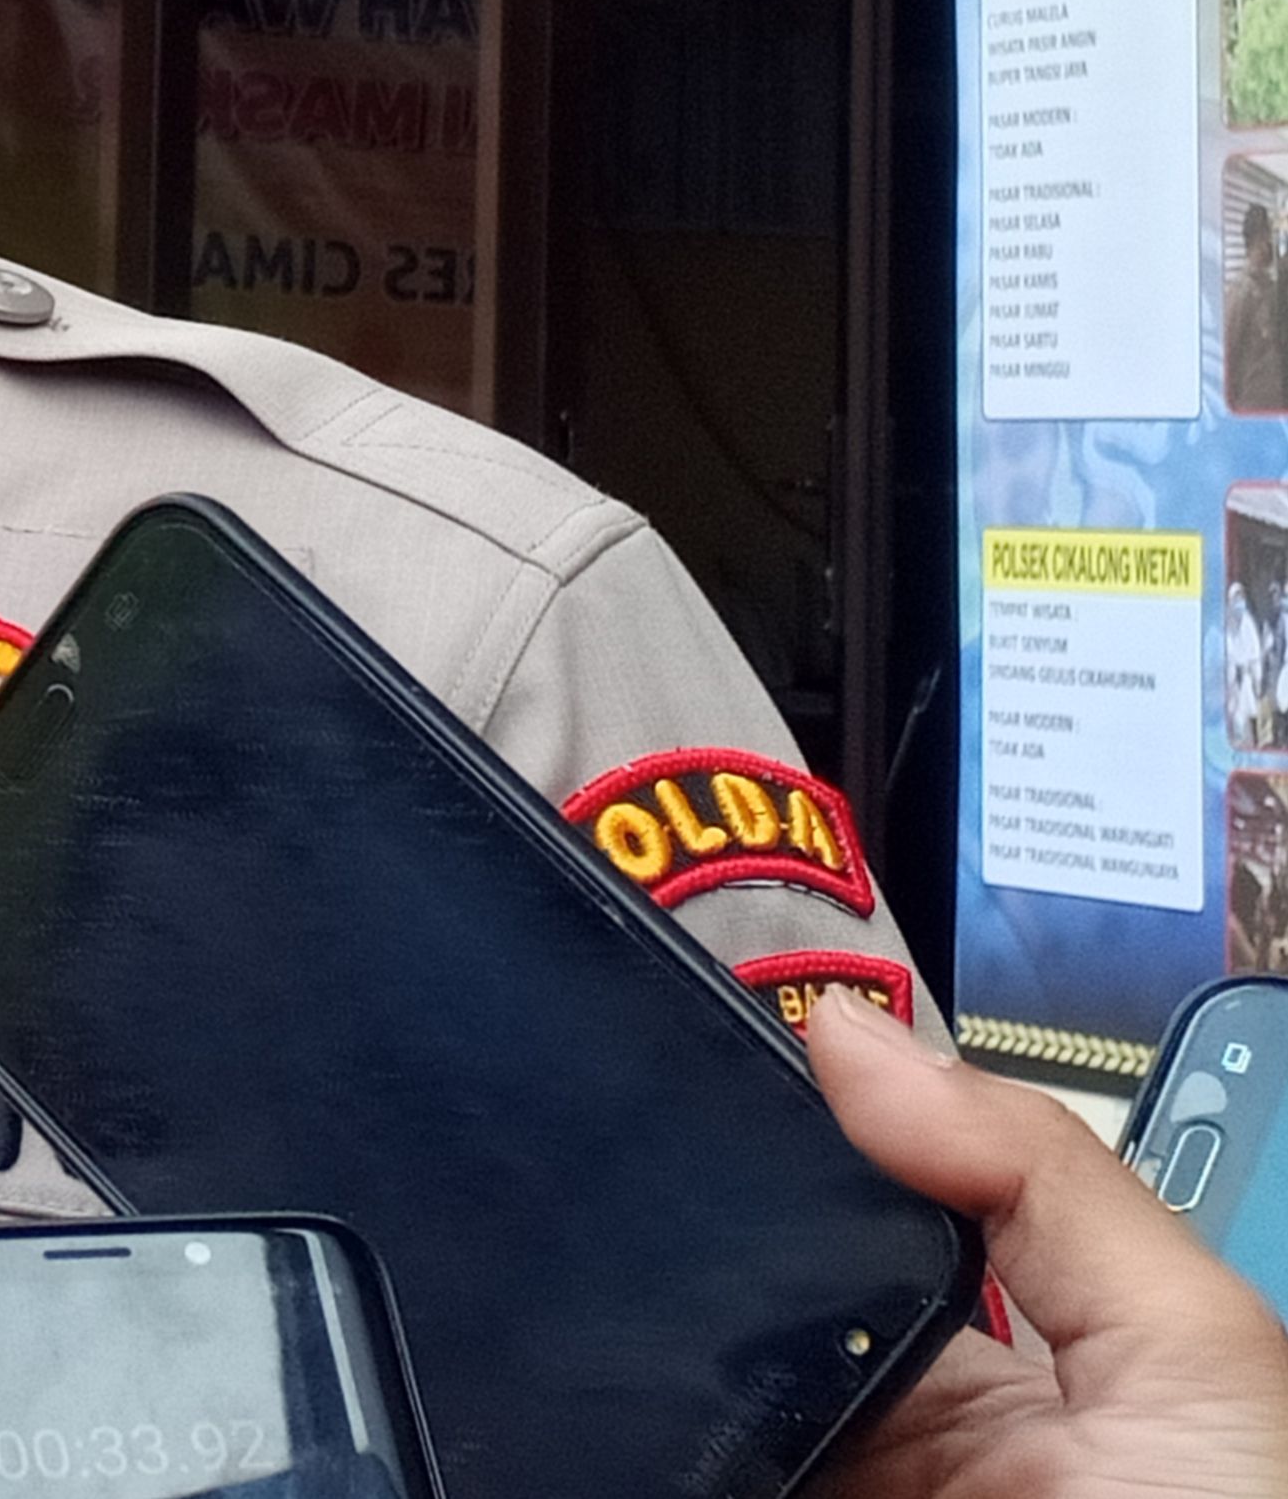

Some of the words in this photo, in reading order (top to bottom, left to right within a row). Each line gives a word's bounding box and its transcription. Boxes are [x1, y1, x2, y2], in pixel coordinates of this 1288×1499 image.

[992, 542, 1049, 580] POLSEK
[1052, 544, 1131, 583] CIKALONG
[1134, 546, 1190, 586] WETAN
[594, 772, 844, 883] OLDA
